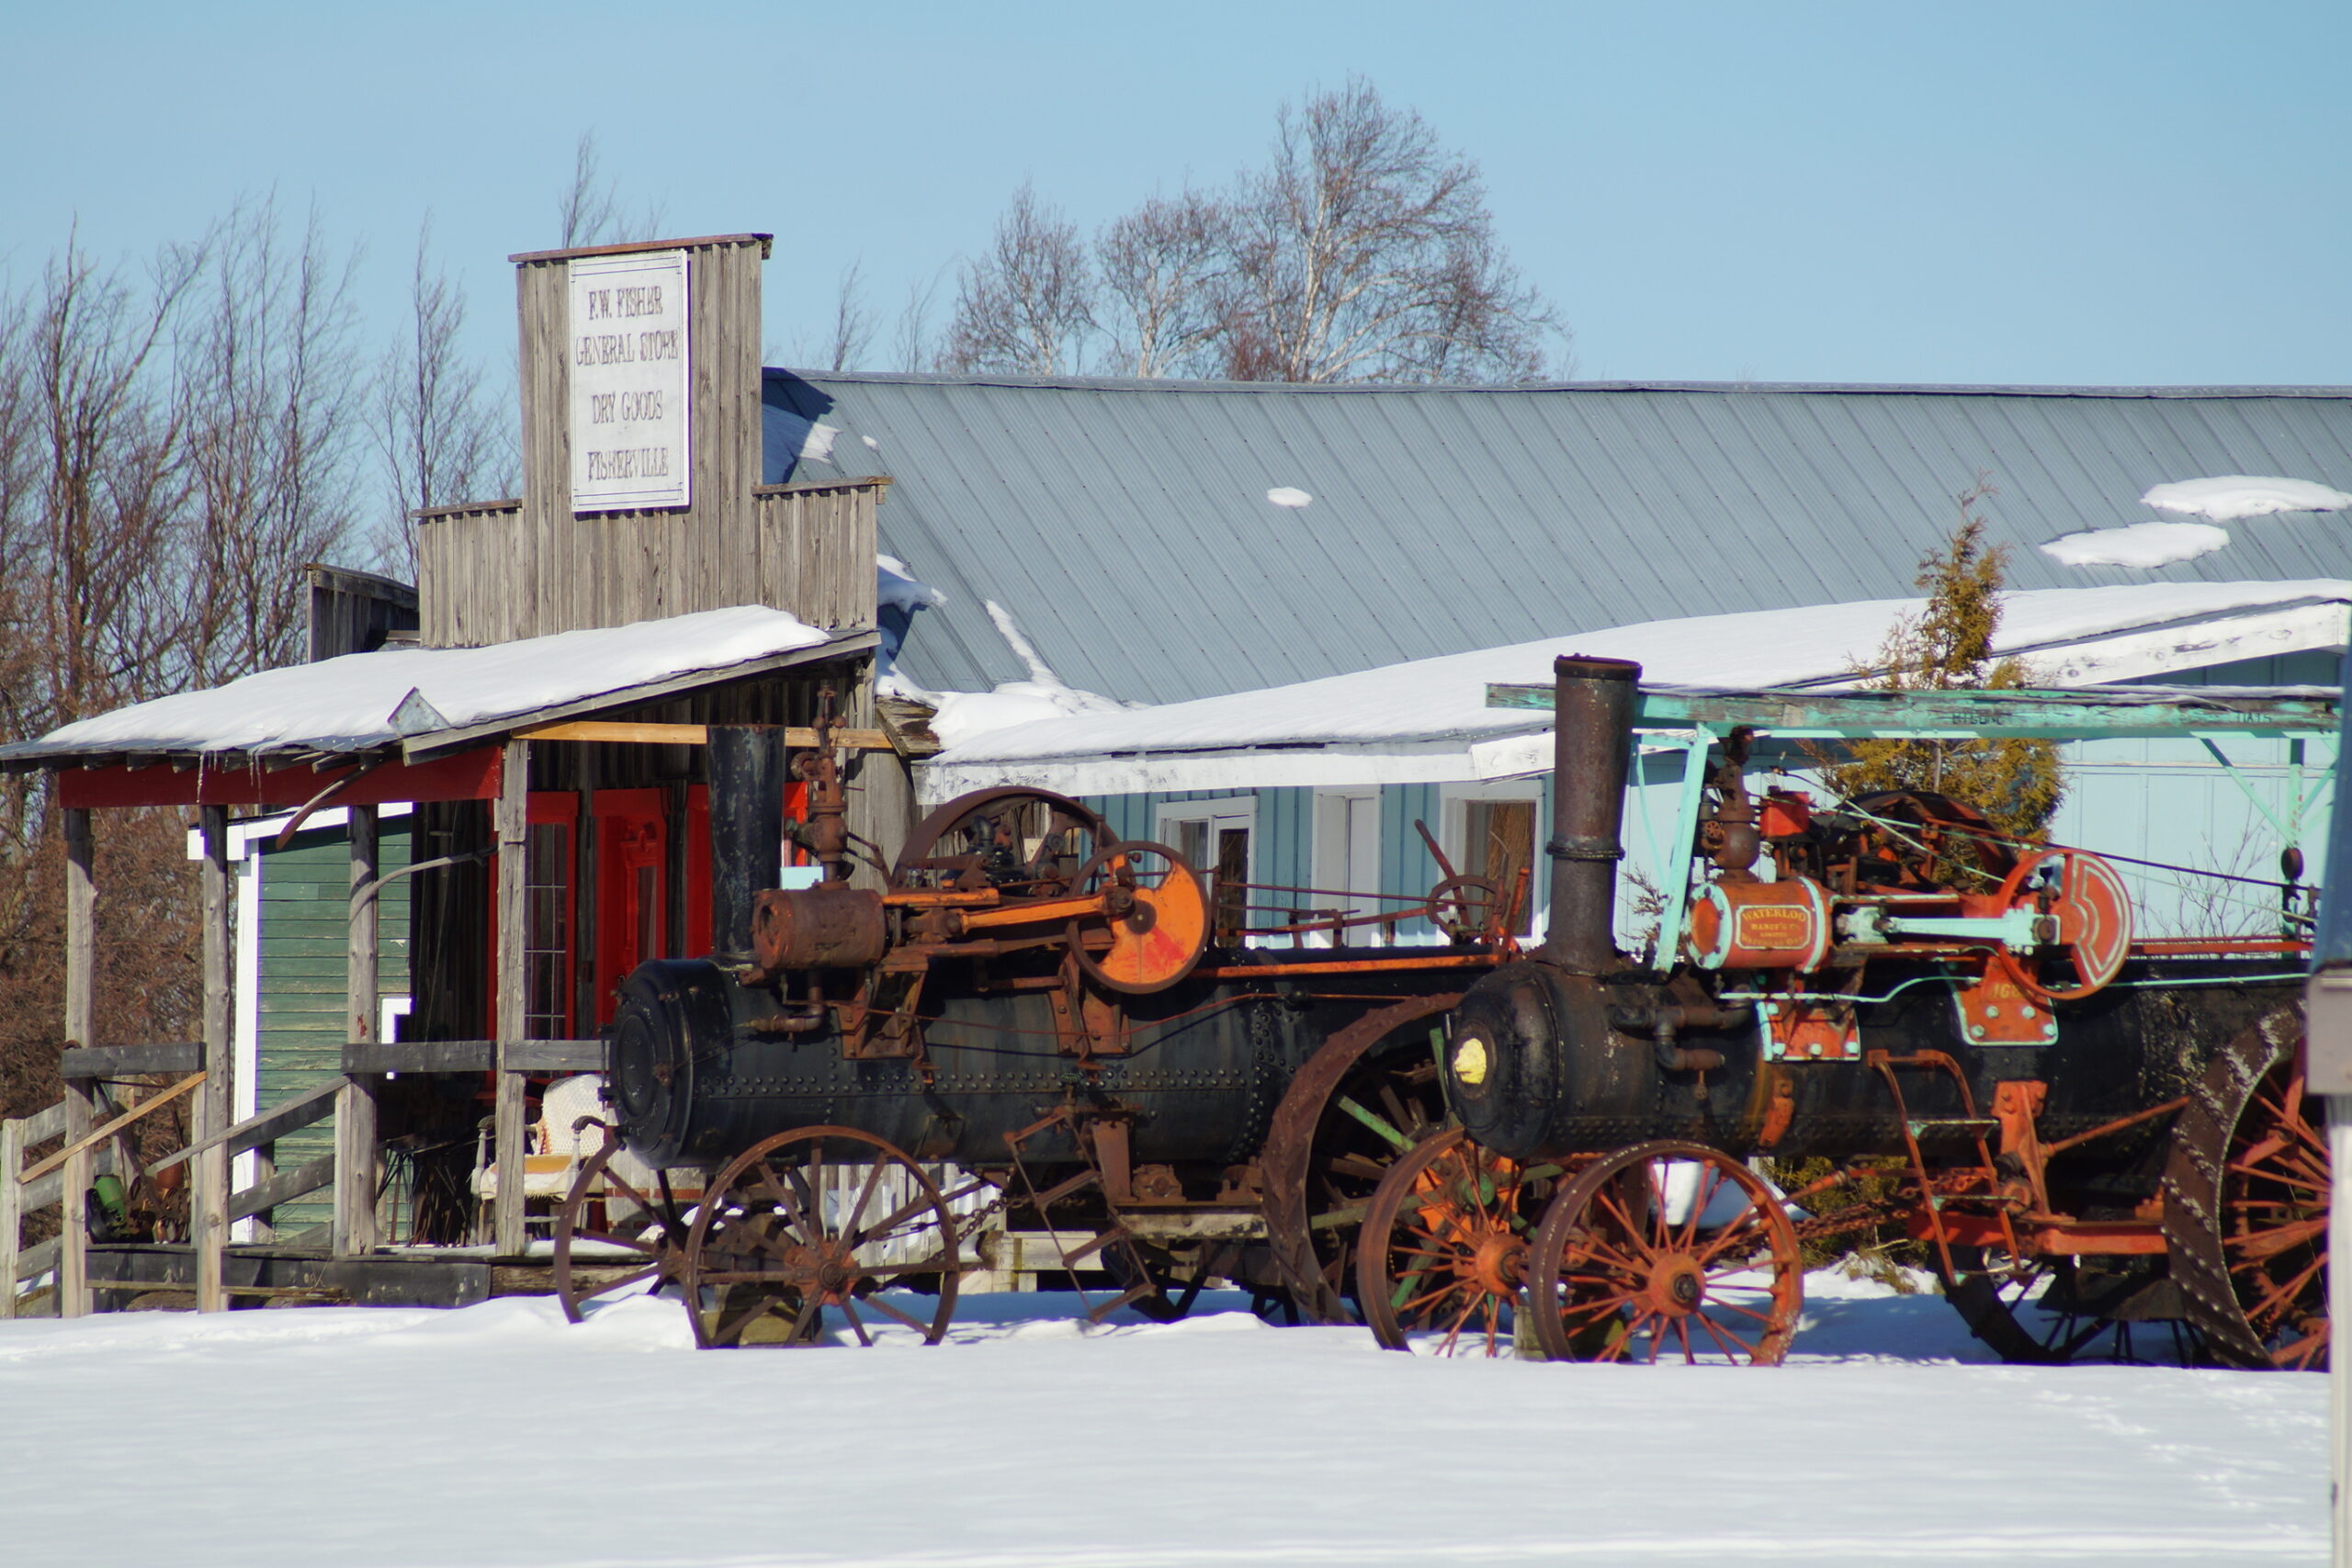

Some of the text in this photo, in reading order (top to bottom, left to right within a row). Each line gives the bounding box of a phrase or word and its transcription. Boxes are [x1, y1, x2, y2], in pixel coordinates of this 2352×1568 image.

[588, 286, 663, 321] F.W. FISHER
[576, 330, 678, 366] GENERAL STORE
[591, 389, 662, 423] DRY GOODS
[587, 447, 669, 482] FISHERVILLE
[1742, 908, 1806, 922] WATERLOO
